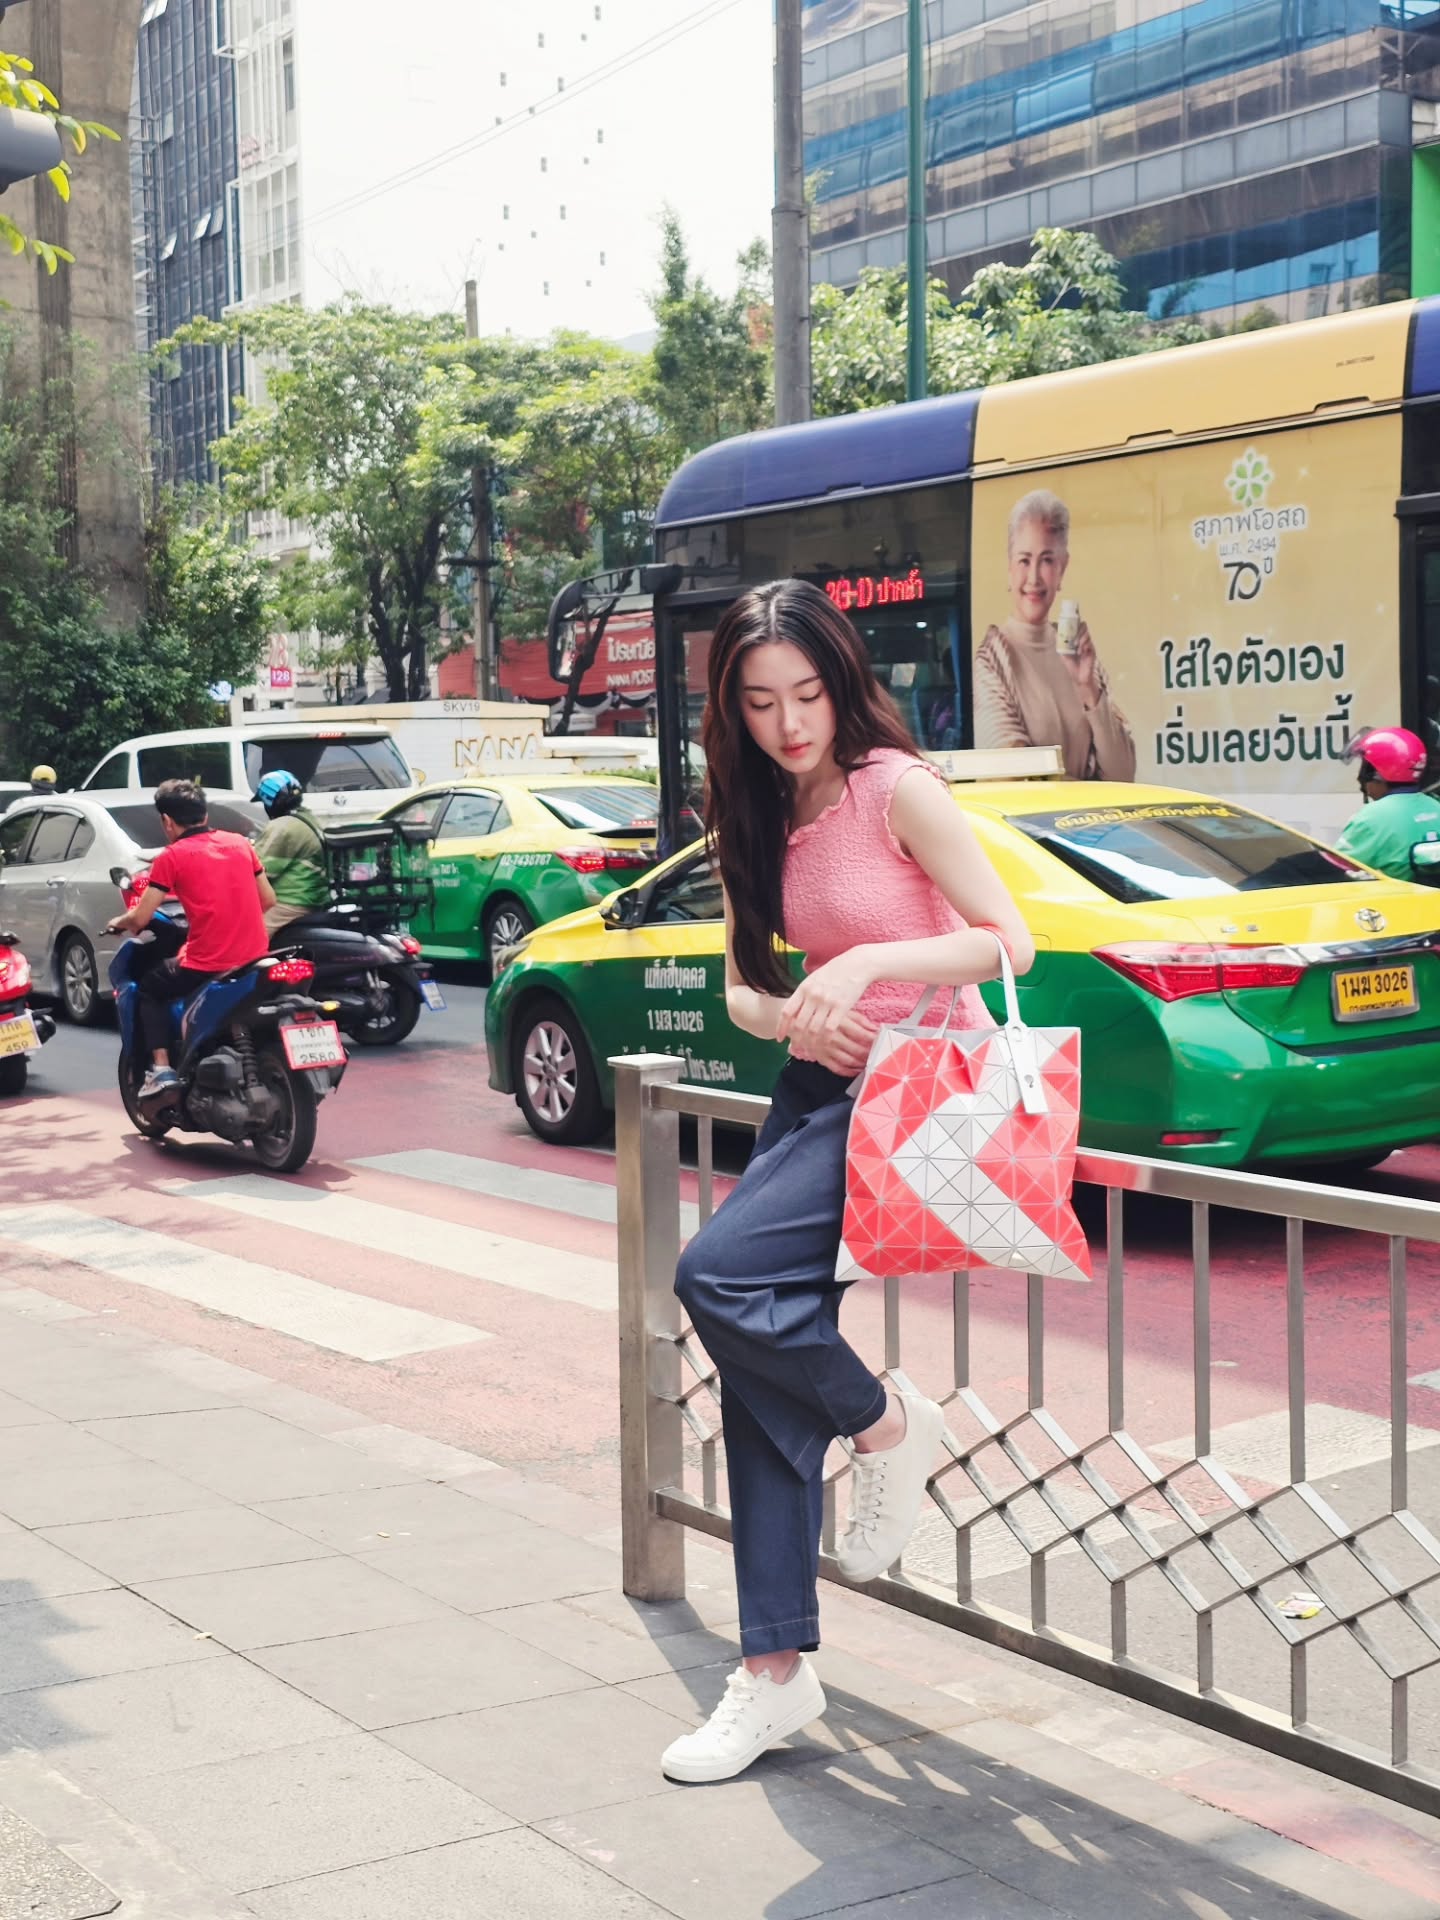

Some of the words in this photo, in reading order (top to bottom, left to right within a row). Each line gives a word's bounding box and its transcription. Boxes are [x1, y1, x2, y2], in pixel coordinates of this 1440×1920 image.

[1194, 507, 1305, 544] สุภาพโอสถ
[1247, 537, 1276, 553] 2494
[1224, 561, 1261, 600] 70
[1264, 556, 1273, 574] ปี
[1159, 637, 1344, 688] ใส่ใจตัวเอง
[271, 670, 290, 682] 128
[443, 702, 480, 712] SKV19
[1156, 693, 1352, 765] เริ่มเลยวันนี้
[455, 733, 538, 768] NANA
[1375, 970, 1408, 993] 3026
[673, 1010, 704, 1032] 3026
[300, 1051, 336, 1064] 2580
